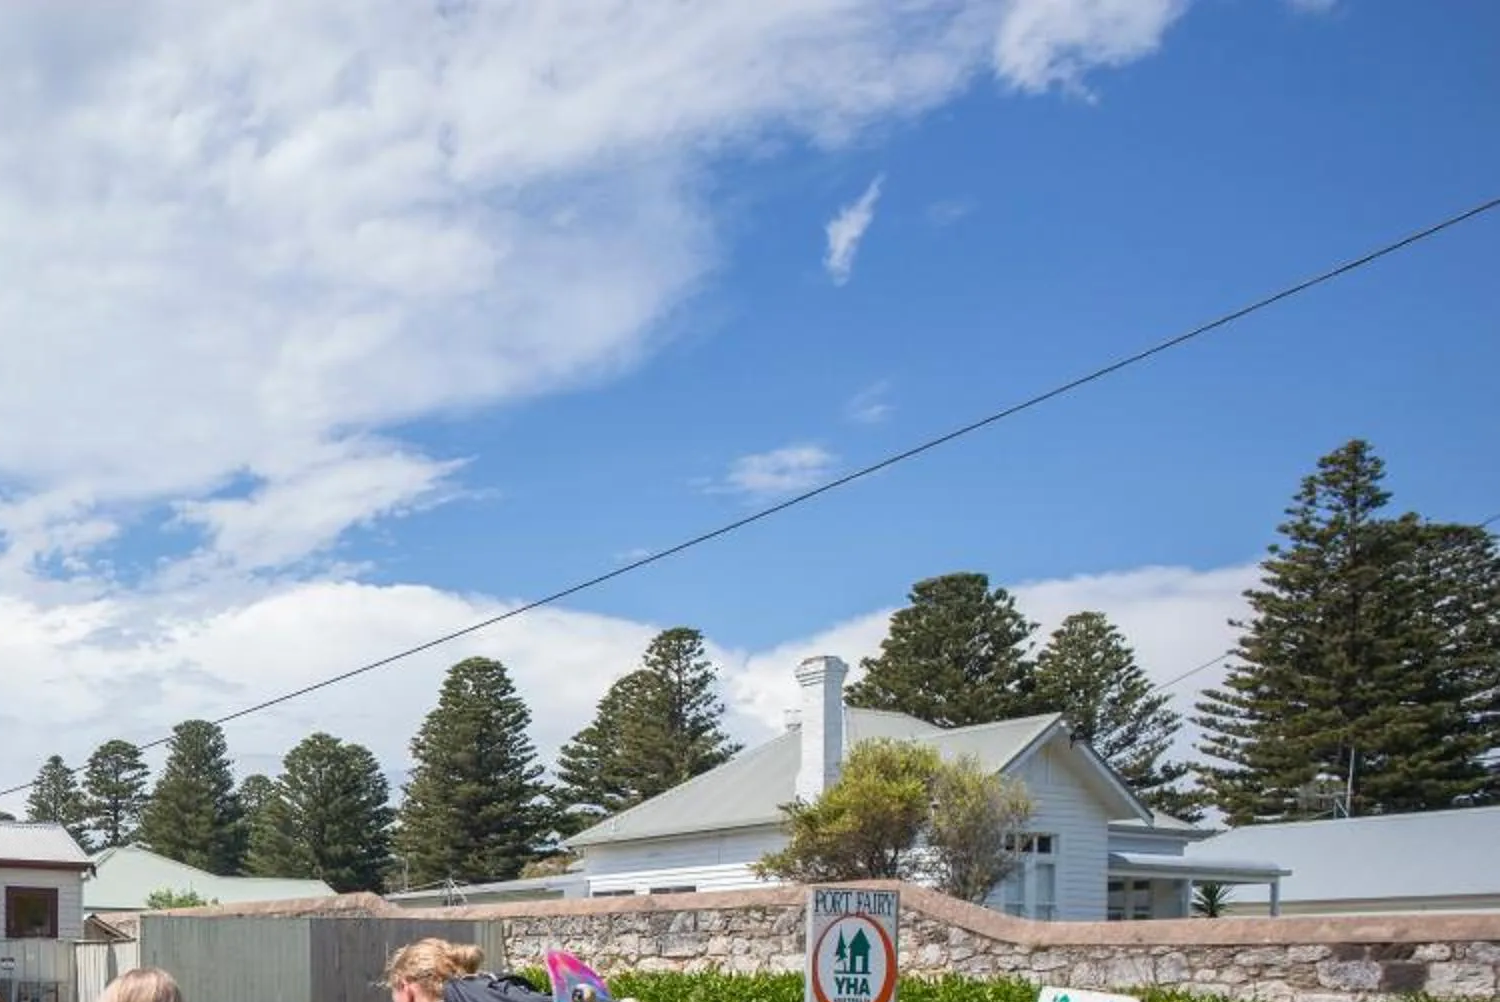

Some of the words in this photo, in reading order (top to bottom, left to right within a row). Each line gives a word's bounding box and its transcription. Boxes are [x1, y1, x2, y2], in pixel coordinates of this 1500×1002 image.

[814, 889, 852, 913] PORT
[857, 891, 895, 916] FAIRY
[834, 976, 871, 996] YHA
